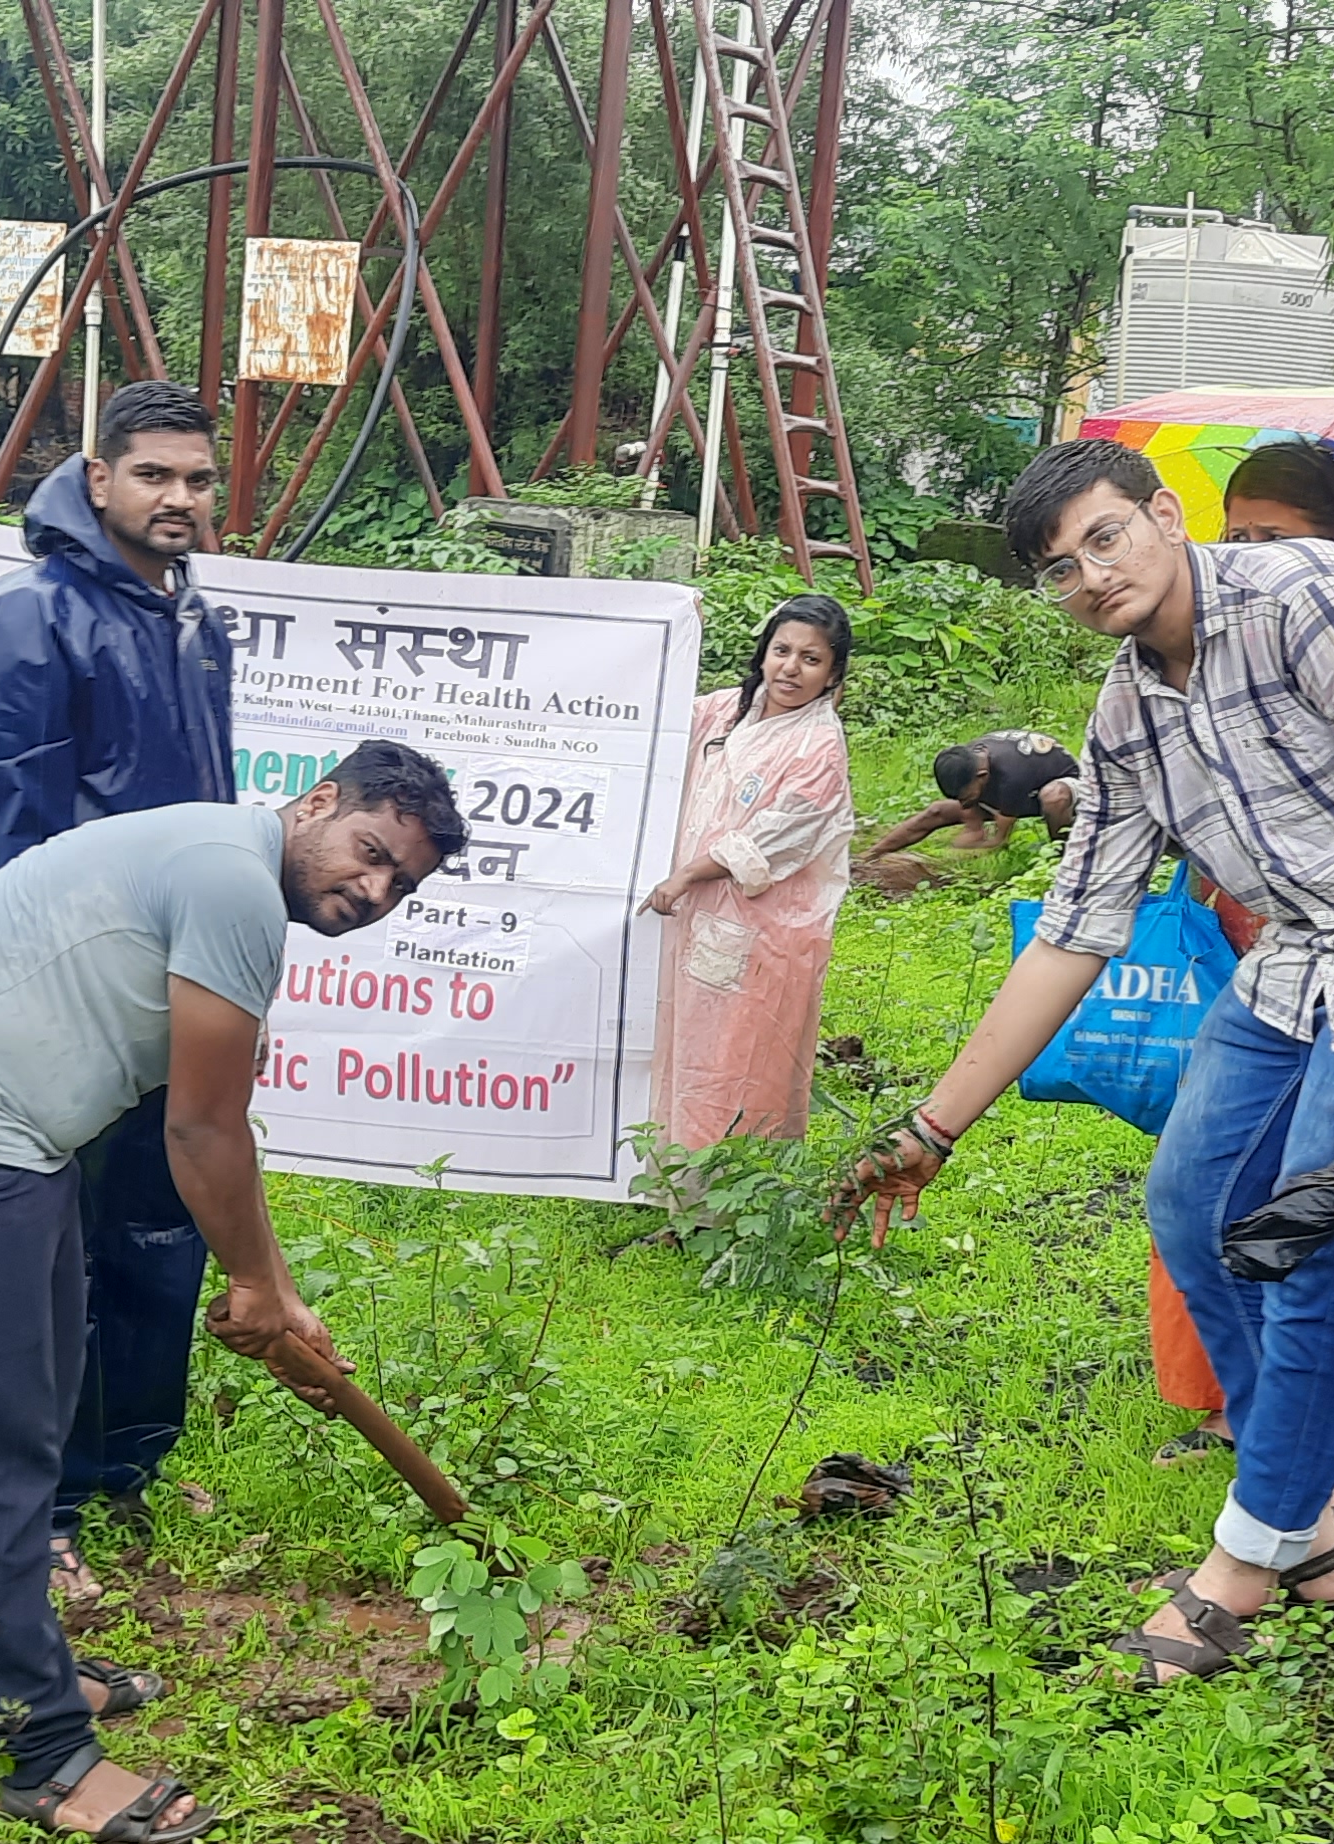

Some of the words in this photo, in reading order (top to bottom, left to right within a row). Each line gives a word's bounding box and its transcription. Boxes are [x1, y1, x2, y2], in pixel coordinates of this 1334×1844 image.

[334, 606, 530, 680] संस्था
[243, 693, 293, 709] Kalyan
[299, 698, 333, 712] West
[372, 676, 425, 701] For
[432, 682, 531, 711] Health
[541, 691, 640, 720] Action
[424, 727, 491, 744] Facebook
[503, 734, 557, 751] Suadha
[561, 739, 599, 754] NGO
[468, 779, 595, 833] 2024
[405, 899, 468, 928] Part
[500, 911, 518, 934] 9
[395, 940, 516, 972] Plantation
[449, 971, 495, 1021] to
